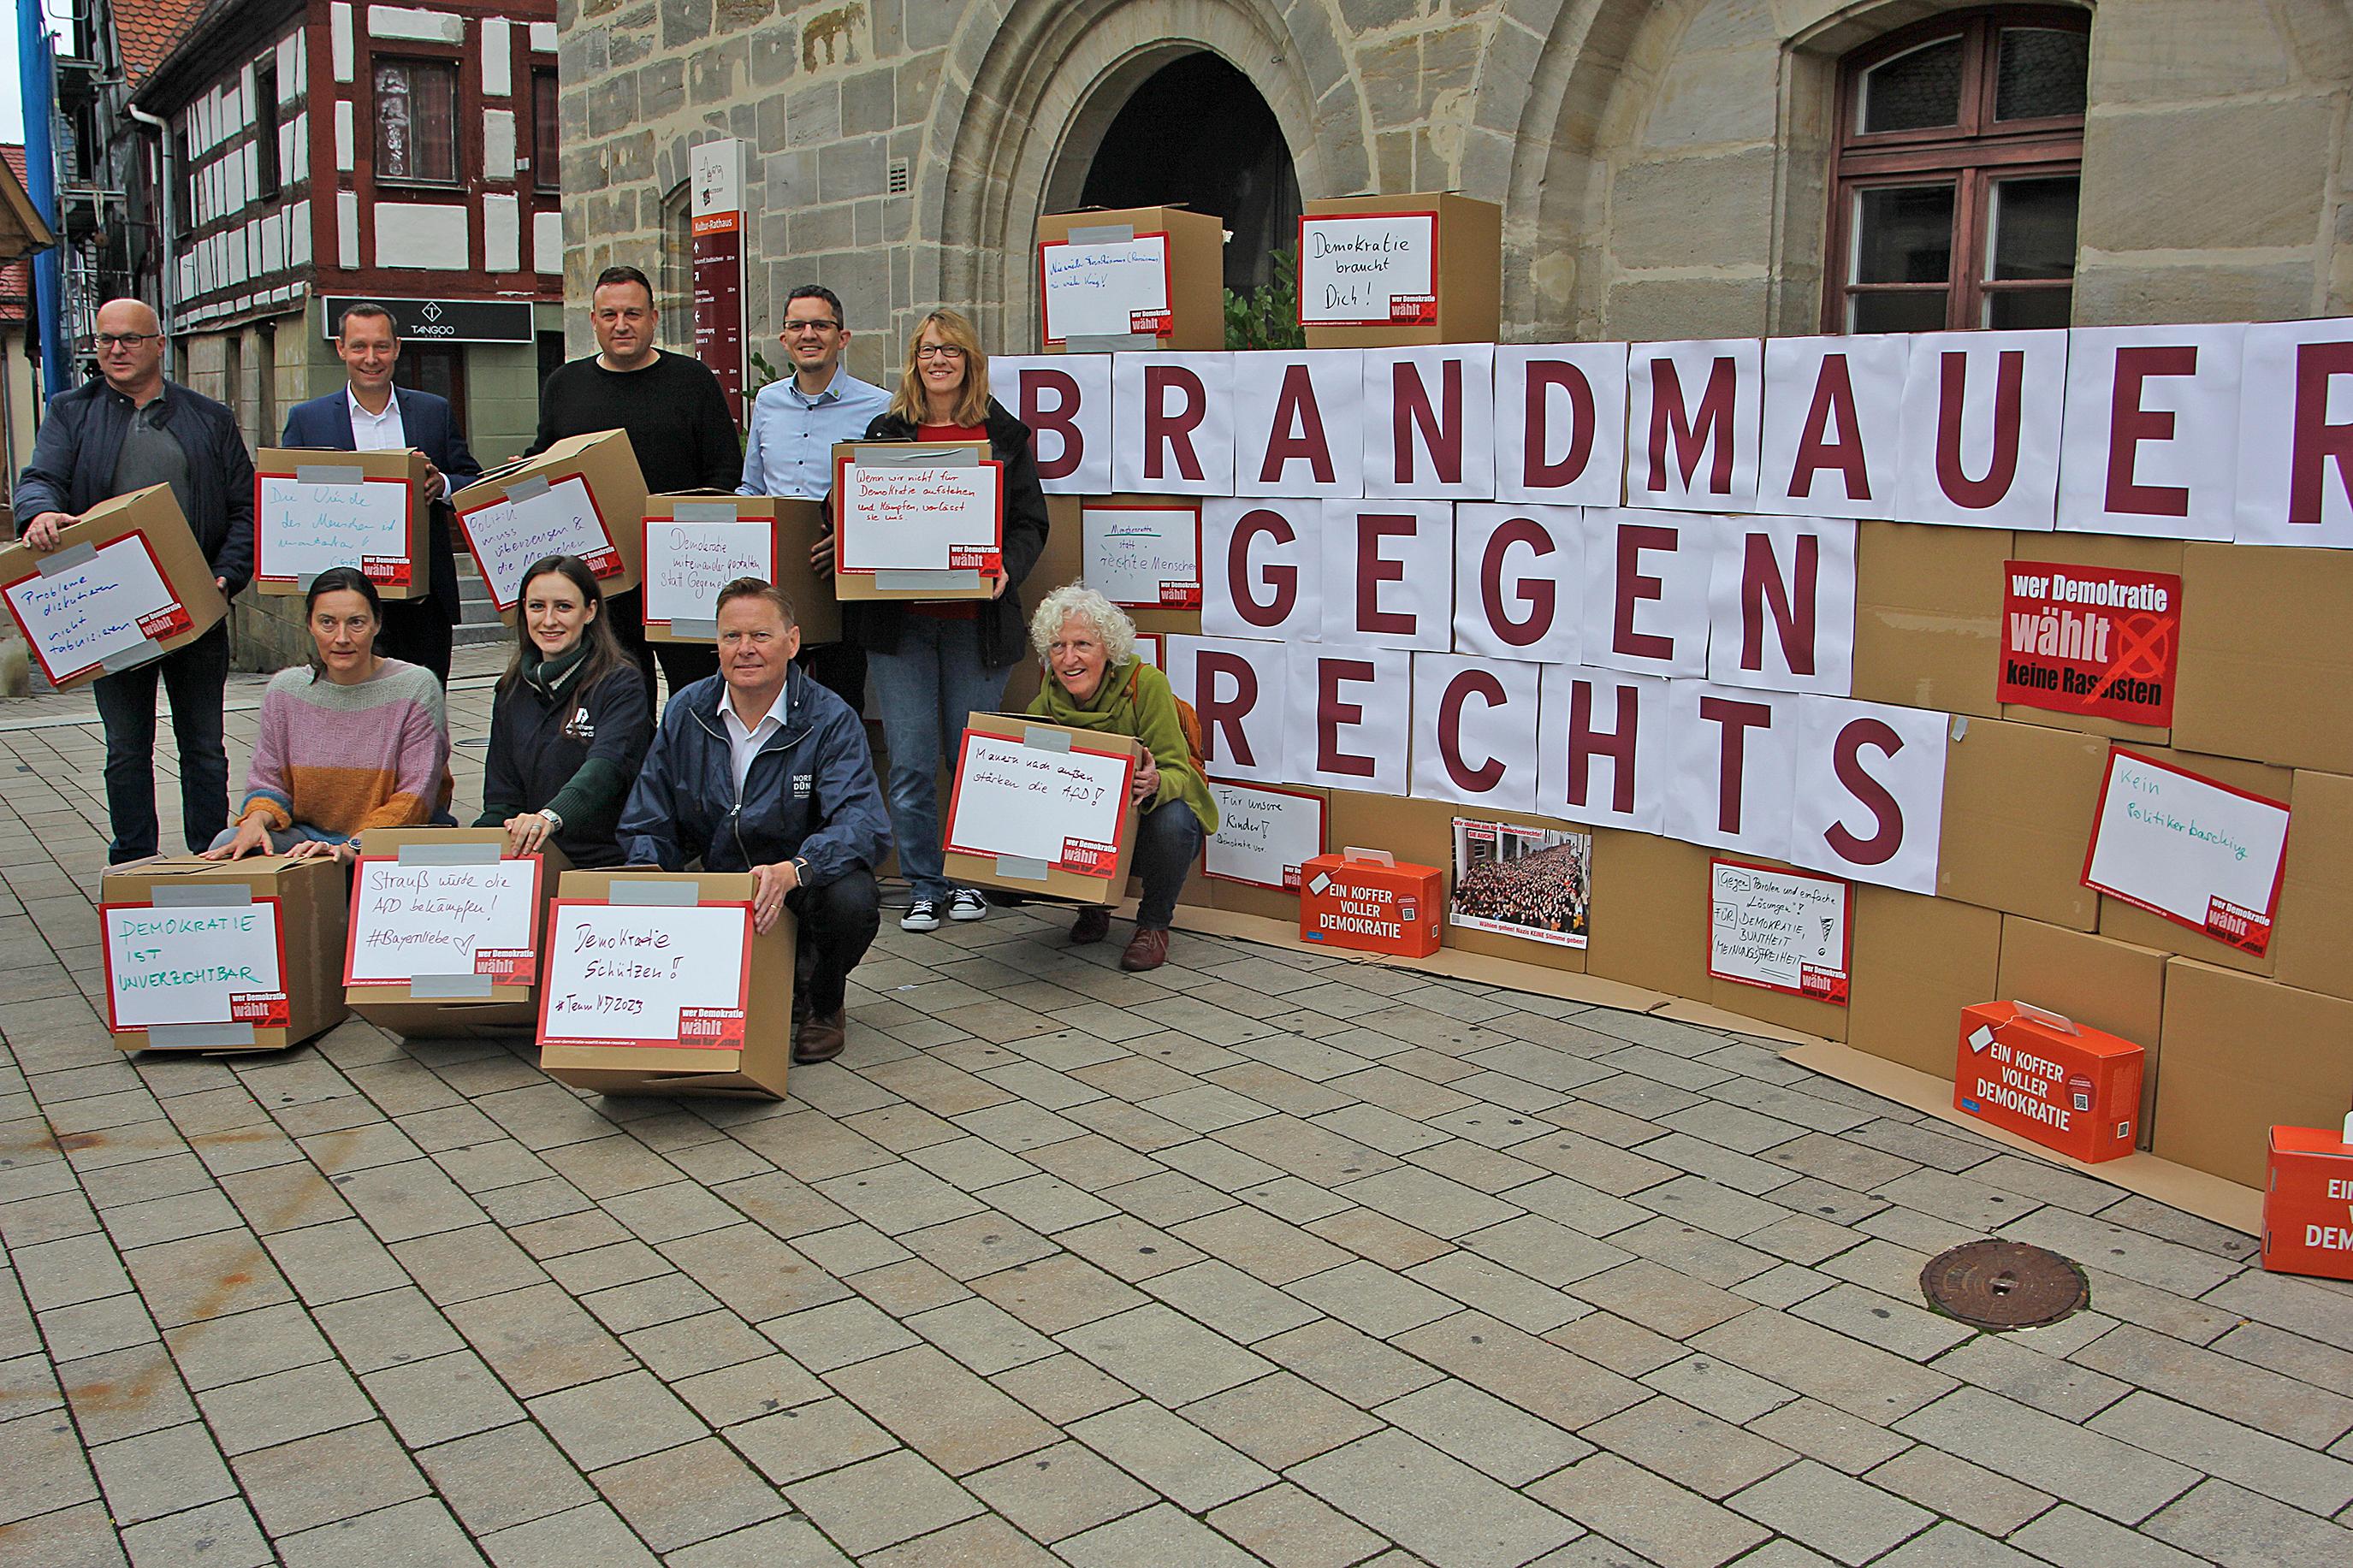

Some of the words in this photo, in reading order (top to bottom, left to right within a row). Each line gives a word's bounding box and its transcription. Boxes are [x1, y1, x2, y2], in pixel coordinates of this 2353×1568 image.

[1313, 232, 1411, 258] Demokratie
[1336, 257, 1390, 274] braucht
[1391, 303, 1420, 316] wählt
[411, 325, 454, 335] TANGOO
[1132, 318, 1159, 330] wählt
[856, 470, 884, 483] Wenn
[908, 470, 933, 482] nicht
[940, 472, 959, 481] für
[923, 487, 976, 497] aufstehen
[922, 501, 965, 512] verlässt
[282, 511, 301, 529] des
[312, 513, 374, 530] Menschen
[572, 516, 587, 530] &
[482, 529, 517, 547] muss
[669, 528, 727, 553] Demokratie
[1119, 539, 1135, 550] statt
[497, 561, 515, 576] die
[951, 554, 983, 566] wählt
[1099, 554, 1148, 571] rechte
[364, 564, 394, 576] wählt
[21, 576, 87, 606] Probleme
[1228, 508, 1818, 677] GEGEN
[2012, 574, 2049, 599] wer
[2052, 574, 2167, 612] Demokratie
[49, 618, 87, 641] nicht
[143, 616, 174, 636] wählt
[2010, 606, 2111, 664] wählt
[2006, 660, 2059, 691] keine
[975, 748, 1019, 764] Mauern
[1057, 766, 1094, 783] außen
[1196, 650, 1906, 866] RECHTS
[973, 772, 1019, 788] stärken
[1028, 780, 1048, 794] die
[2120, 769, 2160, 795] Kein
[1218, 790, 1242, 806] Für
[1064, 848, 1098, 865] wählt
[1079, 840, 1117, 854] Demokratie
[370, 870, 430, 895] Strauß
[439, 872, 478, 888] würde
[485, 873, 512, 888] die
[1720, 872, 1748, 892] Gegen
[1783, 886, 1799, 896] und
[1799, 889, 1836, 906] einfache
[1329, 884, 1347, 897] EIN
[1351, 886, 1392, 903] KOFFER
[372, 898, 402, 914] AfD
[1340, 901, 1380, 918] VOLLER
[1714, 907, 1734, 921] FÜR
[2212, 898, 2226, 909] wer
[2226, 902, 2270, 926] Demokratie
[119, 915, 256, 944] DEMOKRATIE
[1319, 914, 1402, 938] DEMOKRATIE
[2208, 909, 2247, 936] wählt
[366, 929, 450, 950] #Bayernliebe
[1739, 928, 1792, 948] BUNTHEIT
[127, 949, 162, 962] IST
[477, 959, 514, 973] wählt
[119, 966, 264, 991] UNVERZICHTBAR
[1803, 974, 1831, 991] wählt
[233, 1003, 270, 1017] wählt
[698, 1009, 744, 1019] Demokratie
[682, 1019, 722, 1035] wählt
[1990, 1042, 2012, 1062] EIN
[2015, 1050, 2064, 1083] KOFFER
[2001, 1066, 2048, 1098] VOLLER
[1977, 1078, 2071, 1132] DEMOKRATIE
